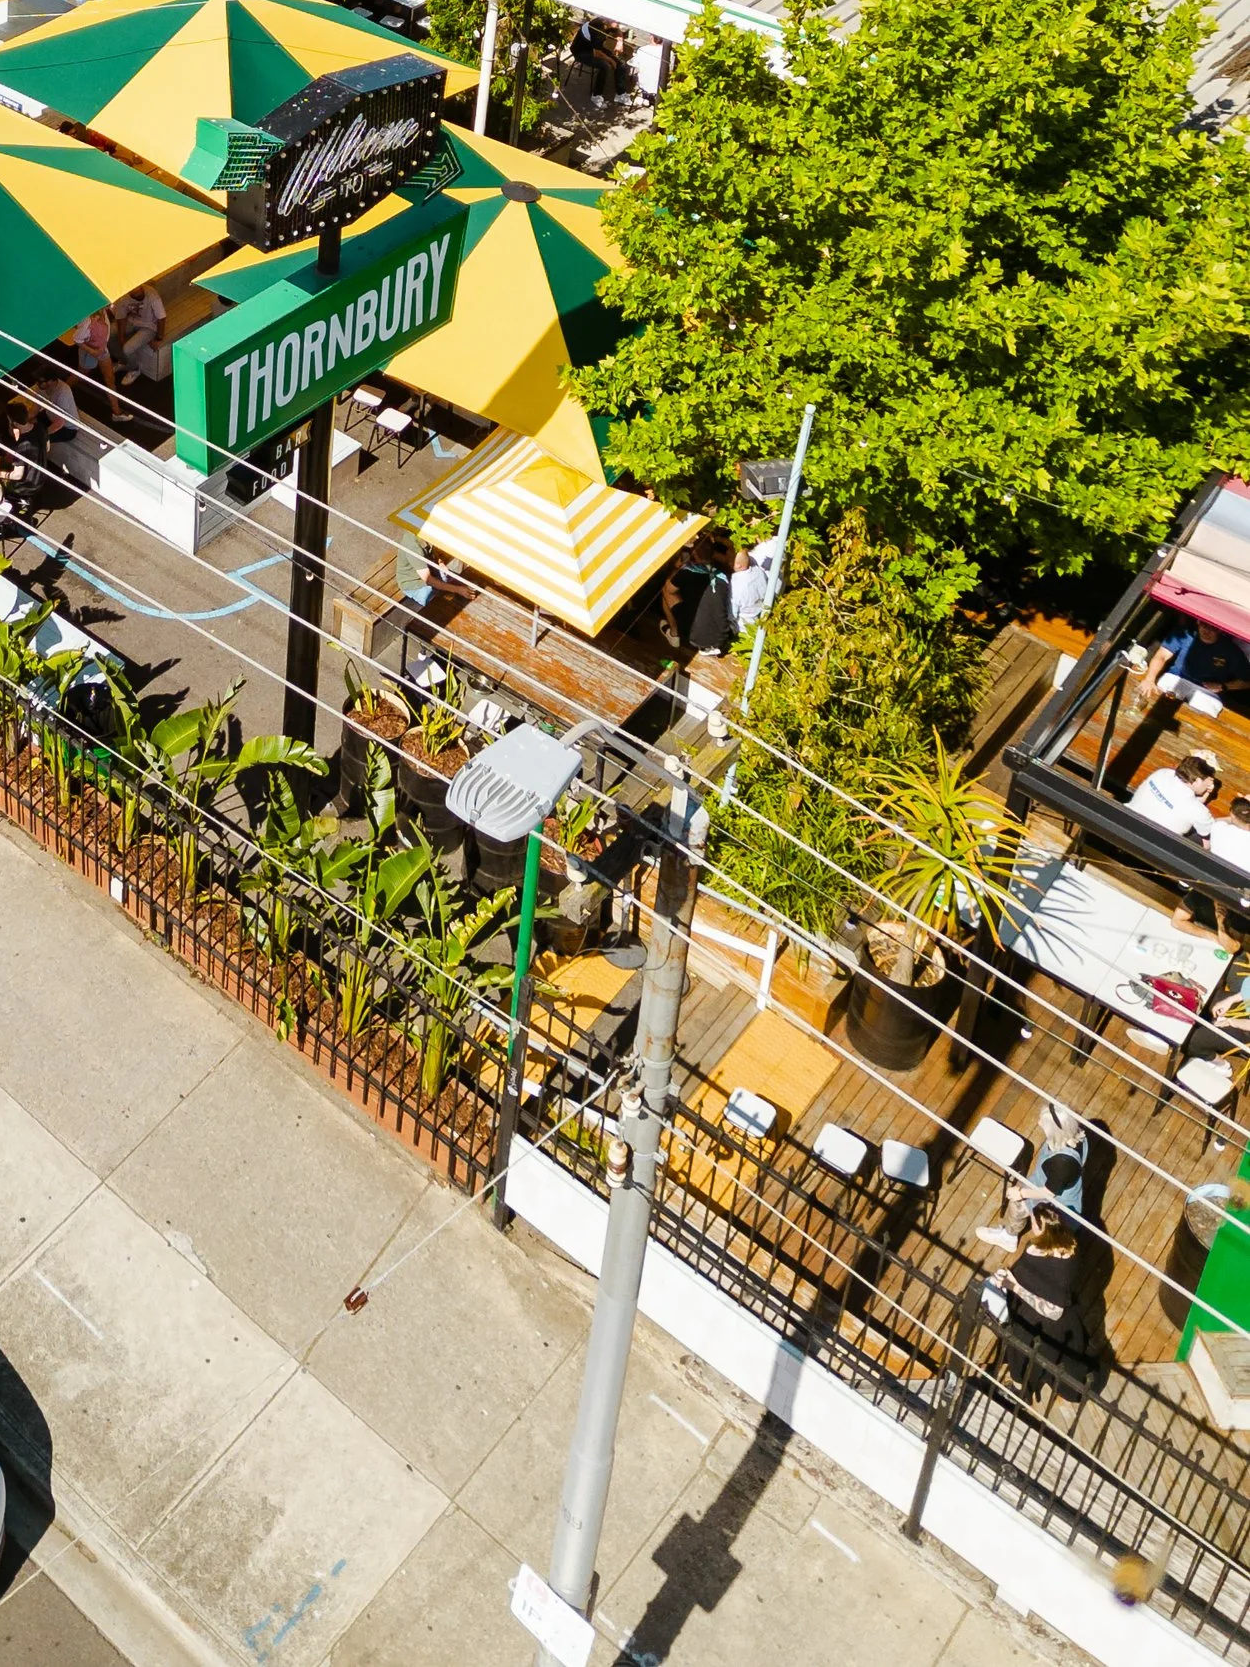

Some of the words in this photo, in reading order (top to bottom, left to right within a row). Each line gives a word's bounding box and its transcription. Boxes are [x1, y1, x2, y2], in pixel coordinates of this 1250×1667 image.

[277, 112, 421, 218] Welcome
[224, 233, 452, 448] THORNBURY
[252, 461, 287, 497] FOOD
[275, 431, 302, 460] BAR
